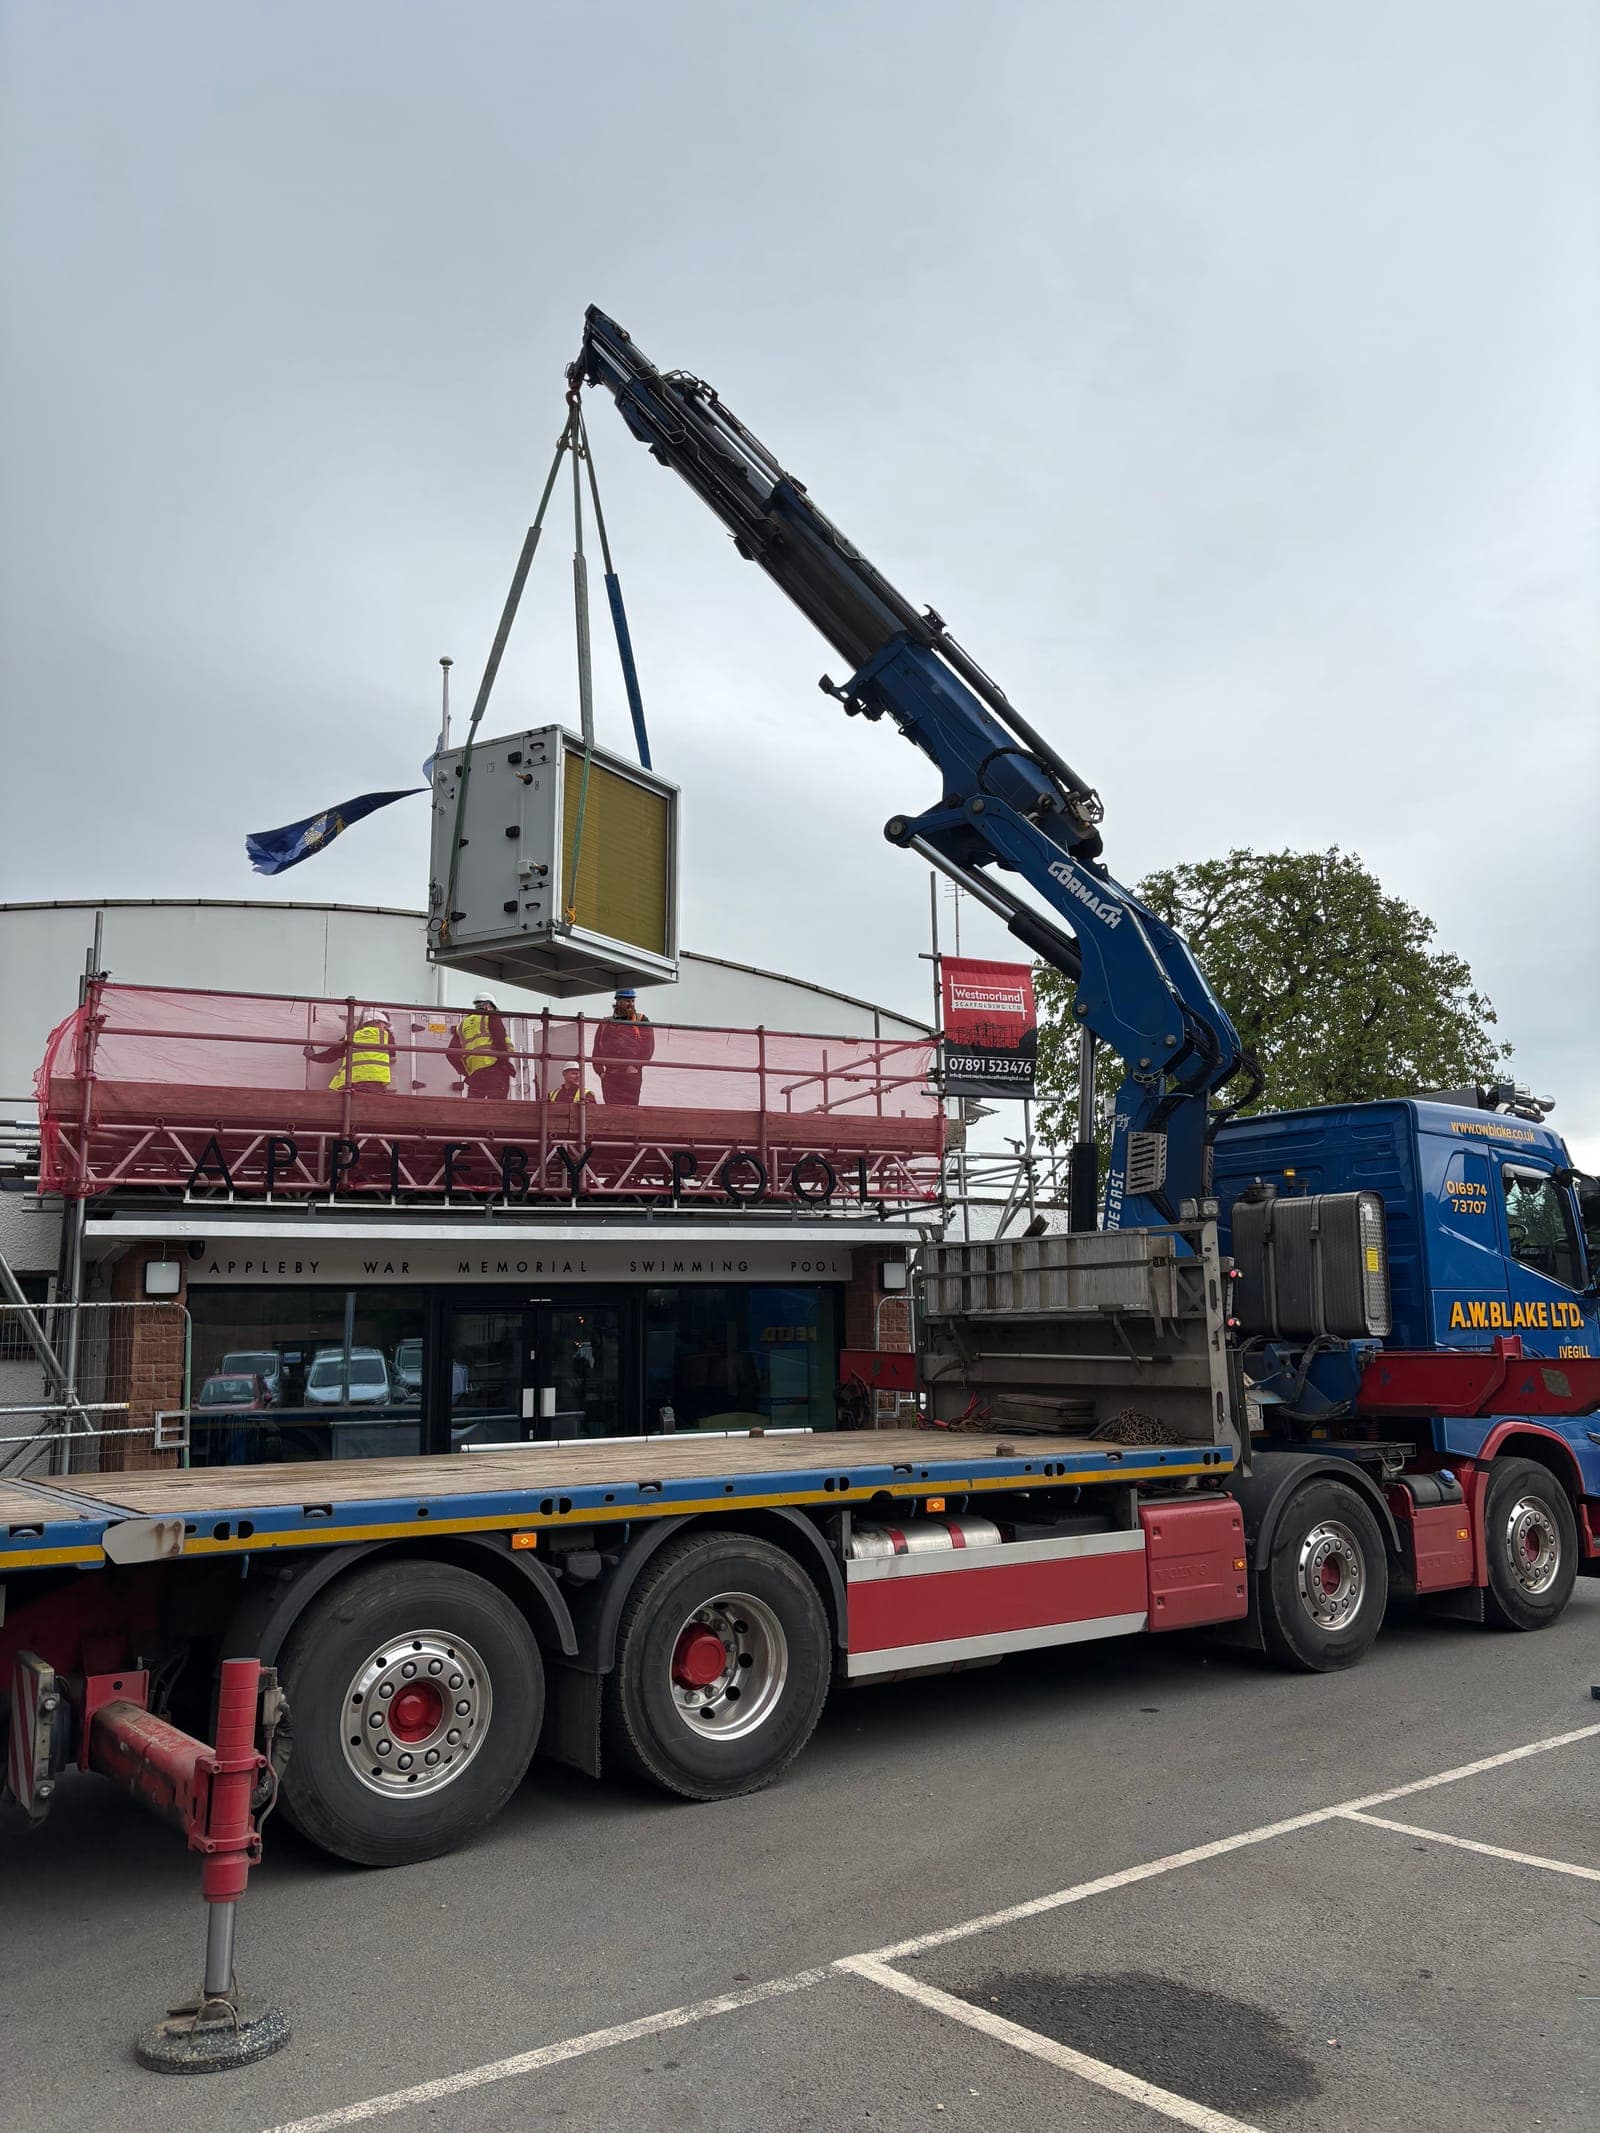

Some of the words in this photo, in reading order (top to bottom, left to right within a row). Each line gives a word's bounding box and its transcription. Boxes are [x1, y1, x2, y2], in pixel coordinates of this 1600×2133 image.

[1047, 861, 1123, 929] CORMACH
[955, 988, 1020, 1002] Westmorland
[955, 1001, 1006, 1010] SCAFFOLDING
[949, 1058, 985, 1072] 07891
[988, 1060, 1032, 1074] 523476
[1450, 1121, 1536, 1142] www.awblake.co.uk
[185, 1136, 593, 1199] APPLEBY
[672, 1151, 881, 1201] POOL
[1446, 1180, 1488, 1196] 016974
[1452, 1199, 1487, 1214] 73707
[209, 1260, 320, 1274] APPLEBY
[363, 1260, 409, 1274] WAR
[457, 1260, 587, 1274] MEMORIAL
[630, 1260, 750, 1273] SWIMMING
[790, 1261, 837, 1273] POOL
[1550, 1302, 1585, 1328] LTD.
[1559, 1345, 1591, 1358] IVEGILL
